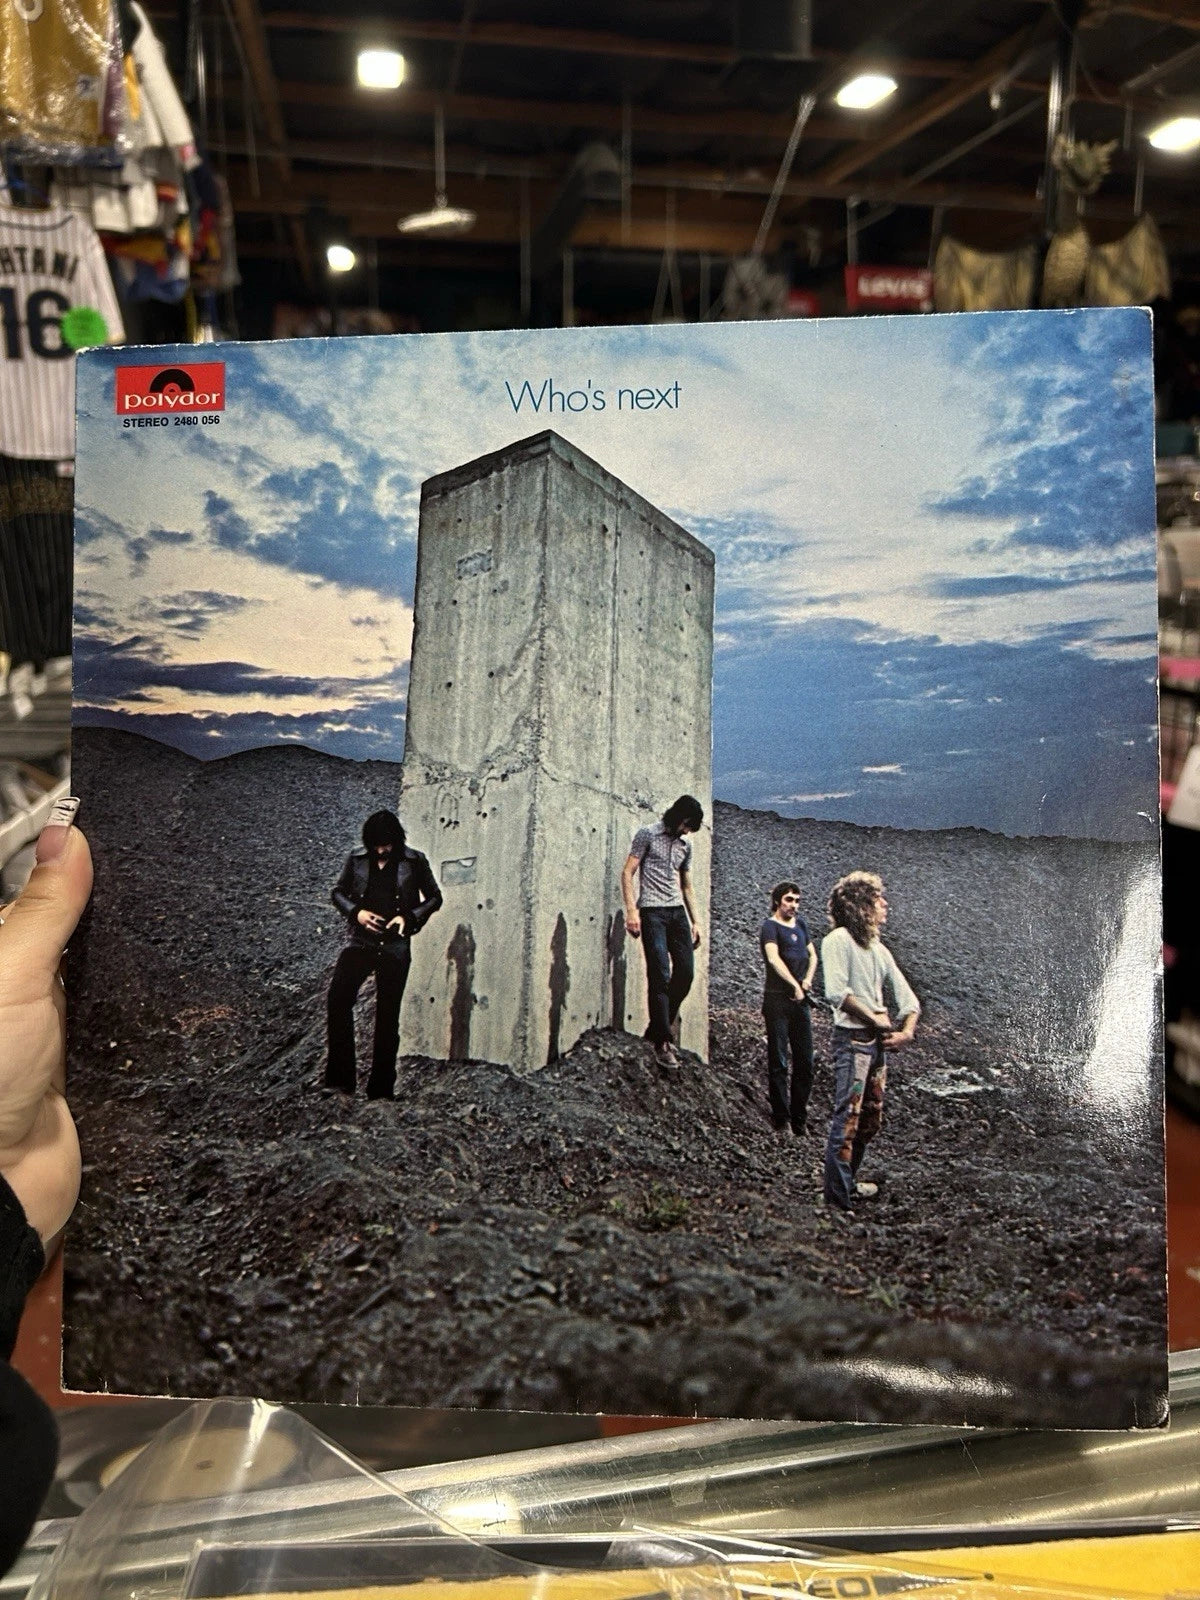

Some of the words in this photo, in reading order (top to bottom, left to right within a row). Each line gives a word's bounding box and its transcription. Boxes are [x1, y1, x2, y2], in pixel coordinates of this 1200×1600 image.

[0, 286, 76, 360] 16
[124, 391, 221, 410] polydor
[504, 378, 606, 414] Who's
[618, 380, 682, 411] next
[123, 417, 169, 428] STEREO
[174, 416, 198, 426] 2480
[202, 415, 220, 425] 056
